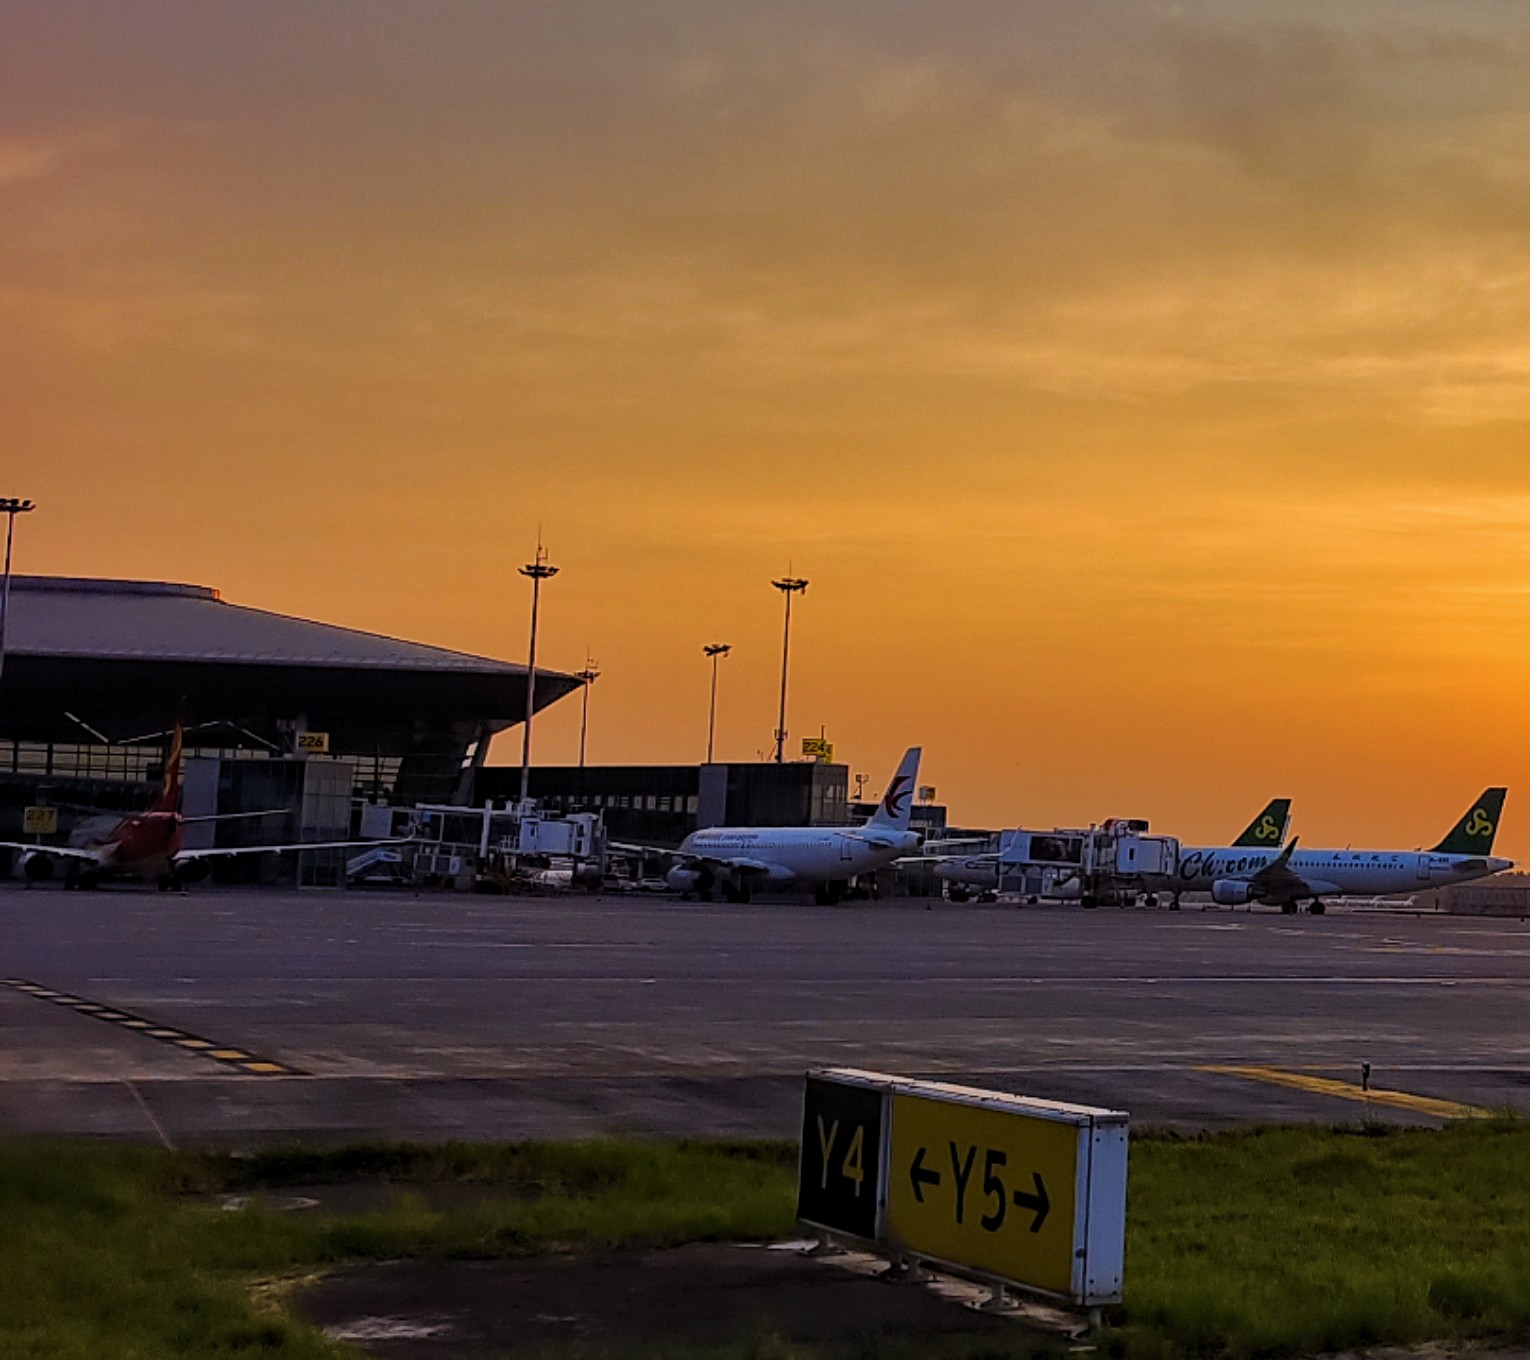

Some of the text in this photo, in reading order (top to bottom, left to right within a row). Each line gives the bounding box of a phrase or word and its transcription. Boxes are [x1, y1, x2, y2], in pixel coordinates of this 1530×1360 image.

[298, 735, 324, 747] 226
[803, 741, 826, 753] 224
[818, 1115, 864, 1197] Y4
[949, 1141, 1007, 1232] Y5
